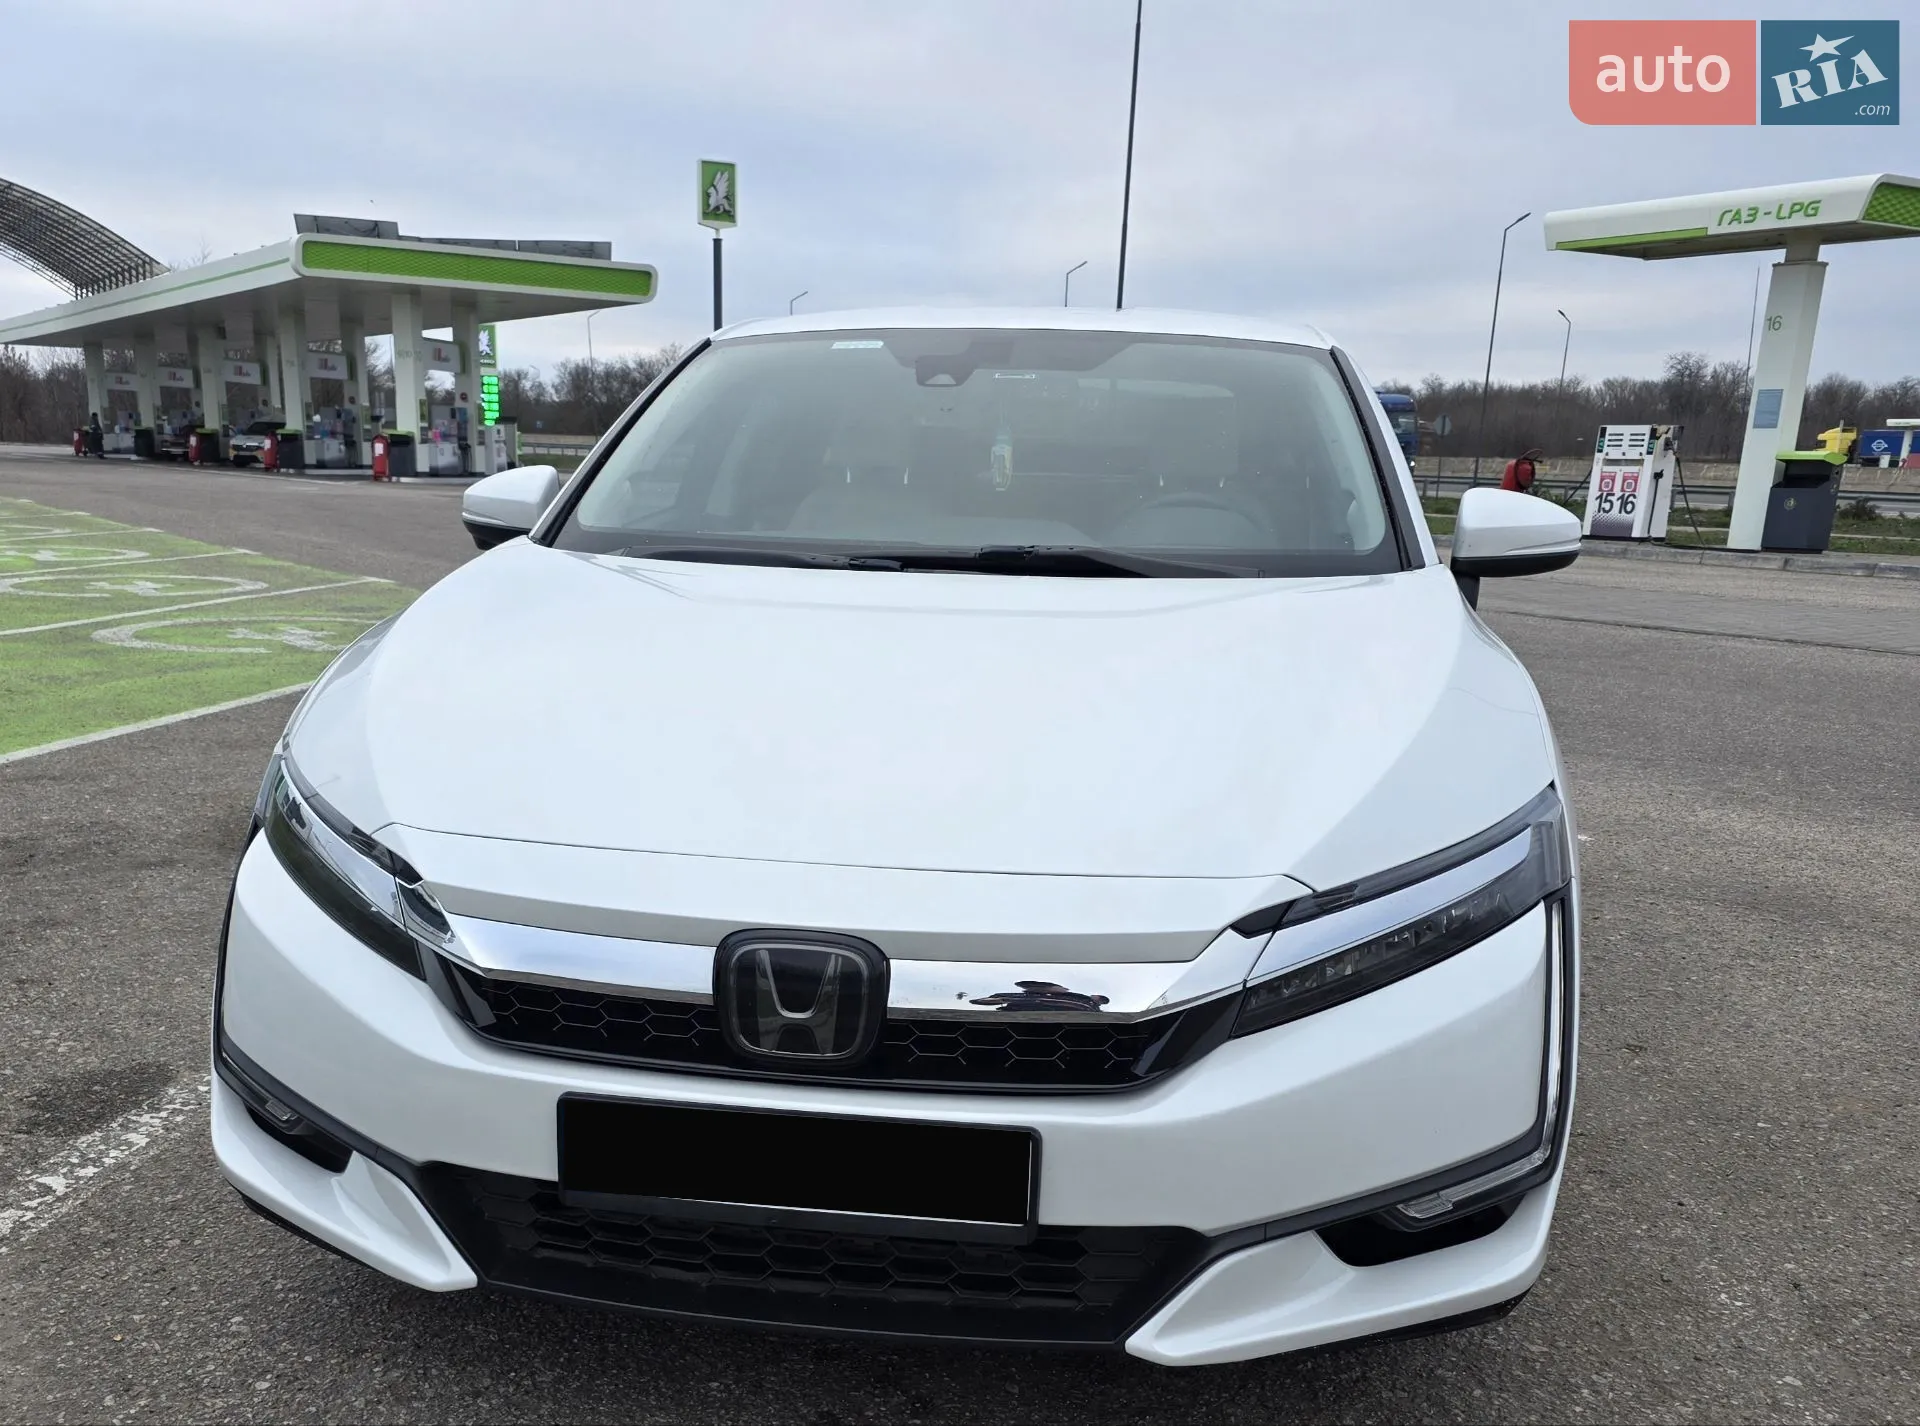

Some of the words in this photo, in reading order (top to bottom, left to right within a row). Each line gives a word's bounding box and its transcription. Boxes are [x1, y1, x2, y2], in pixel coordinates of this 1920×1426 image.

[1767, 315, 1783, 331] 16
[1595, 492, 1616, 514] 15
[1616, 493, 1637, 515] 16
